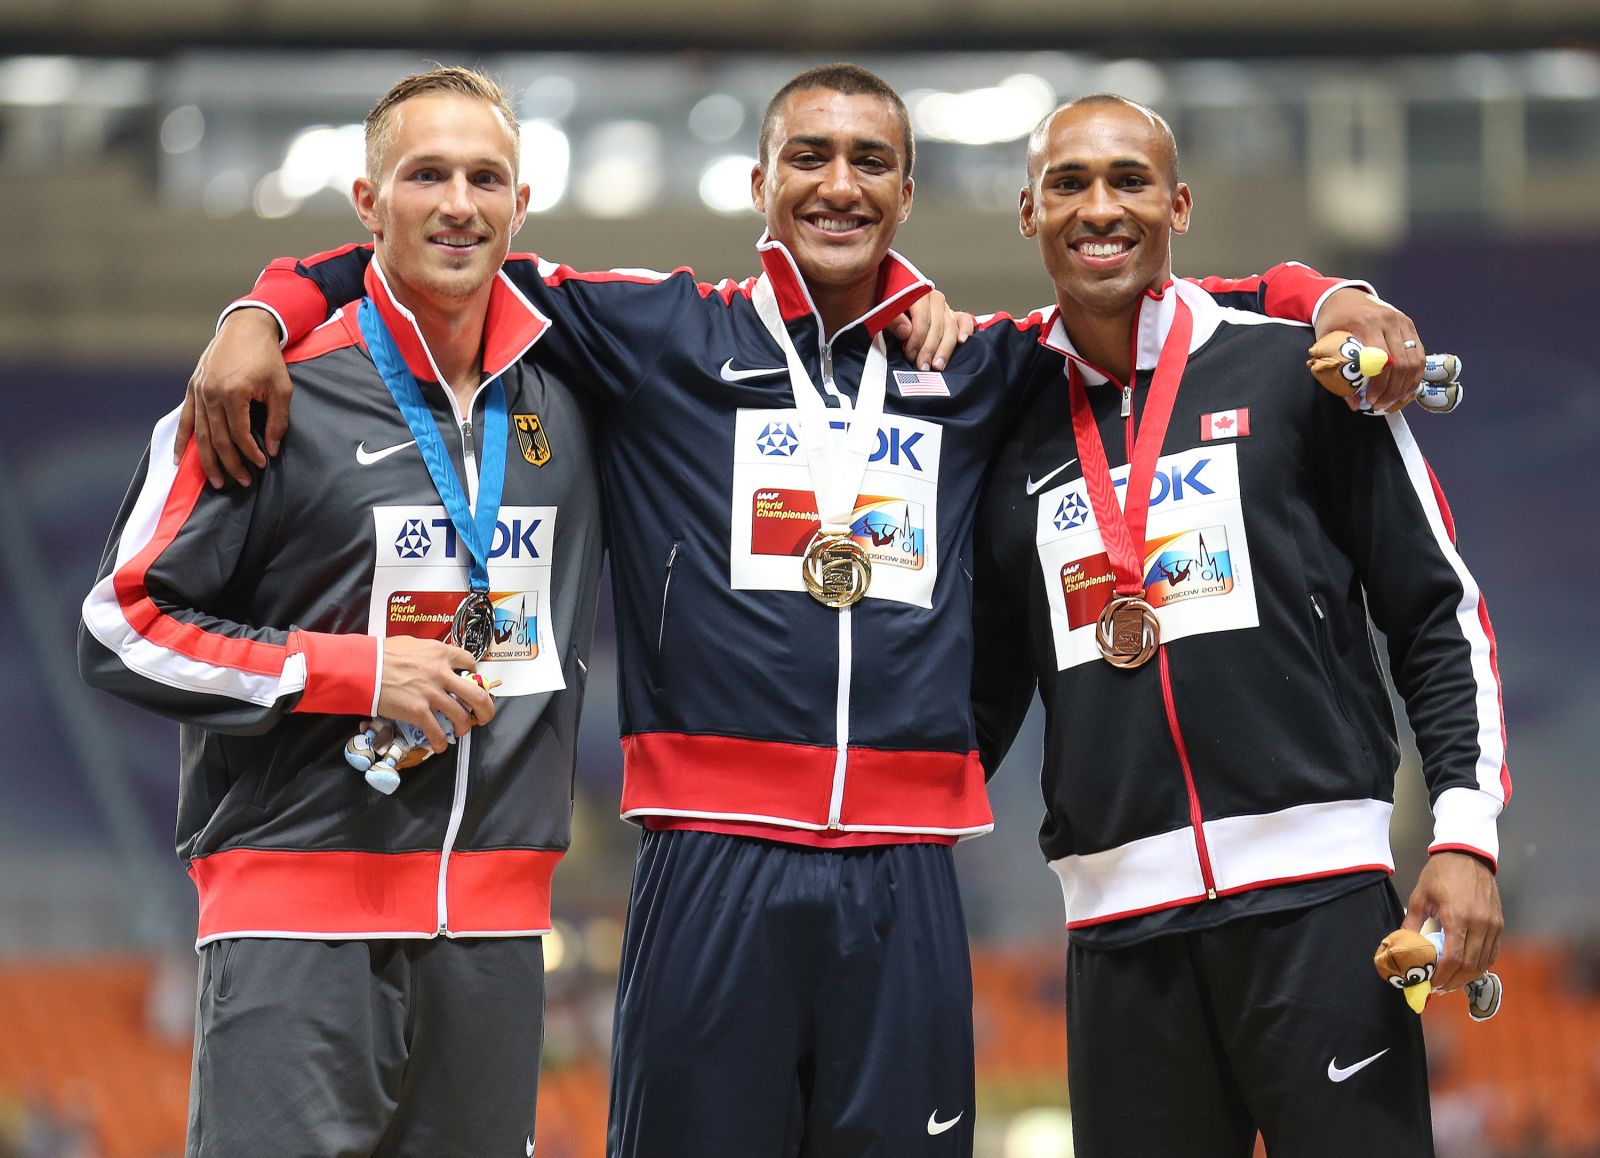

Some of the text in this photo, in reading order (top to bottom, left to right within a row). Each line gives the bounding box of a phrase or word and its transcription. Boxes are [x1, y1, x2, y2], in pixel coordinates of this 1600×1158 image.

[756, 492, 780, 500] IAAF
[756, 500, 784, 510] World
[756, 508, 820, 522] Championship
[867, 553, 917, 567] OSCOW 2013
[1063, 563, 1081, 576] IAAF
[1064, 570, 1085, 585] World
[391, 595, 412, 604] IAAF
[1161, 585, 1224, 602] MOSCOW 2013
[390, 603, 416, 614] World
[390, 612, 455, 624] Championships
